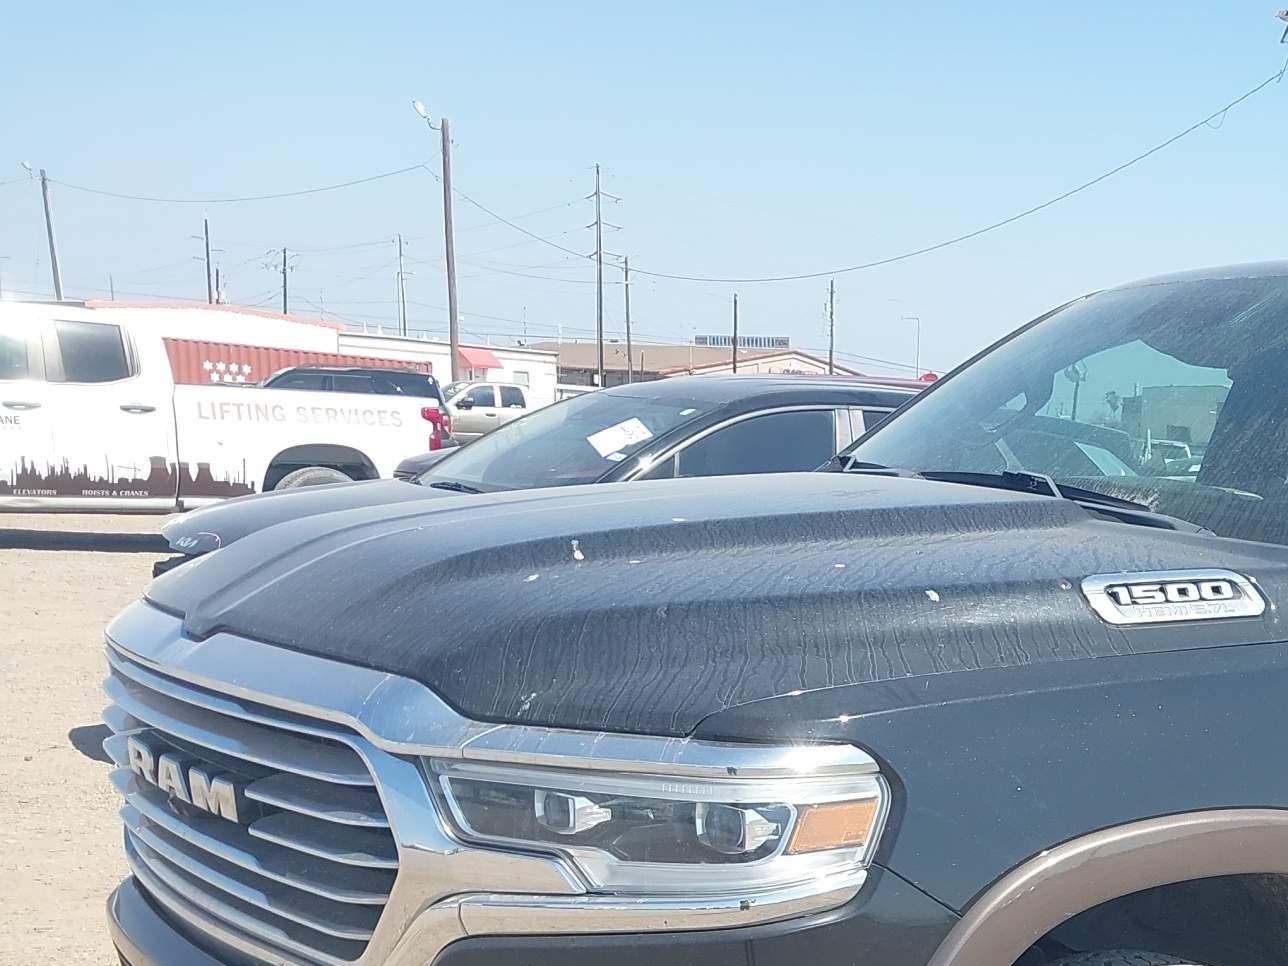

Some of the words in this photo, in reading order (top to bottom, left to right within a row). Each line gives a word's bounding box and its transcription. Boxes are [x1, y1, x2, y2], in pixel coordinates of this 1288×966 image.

[196, 401, 287, 423] LIFTING
[296, 405, 404, 428] SERVICES
[13, 488, 57, 496] ELEVATORS
[119, 489, 149, 497] CRANES
[1107, 580, 1234, 606] 1500
[1134, 604, 1192, 618] HEMI
[1193, 602, 1237, 616] 5.7L
[127, 735, 239, 824] RAM
